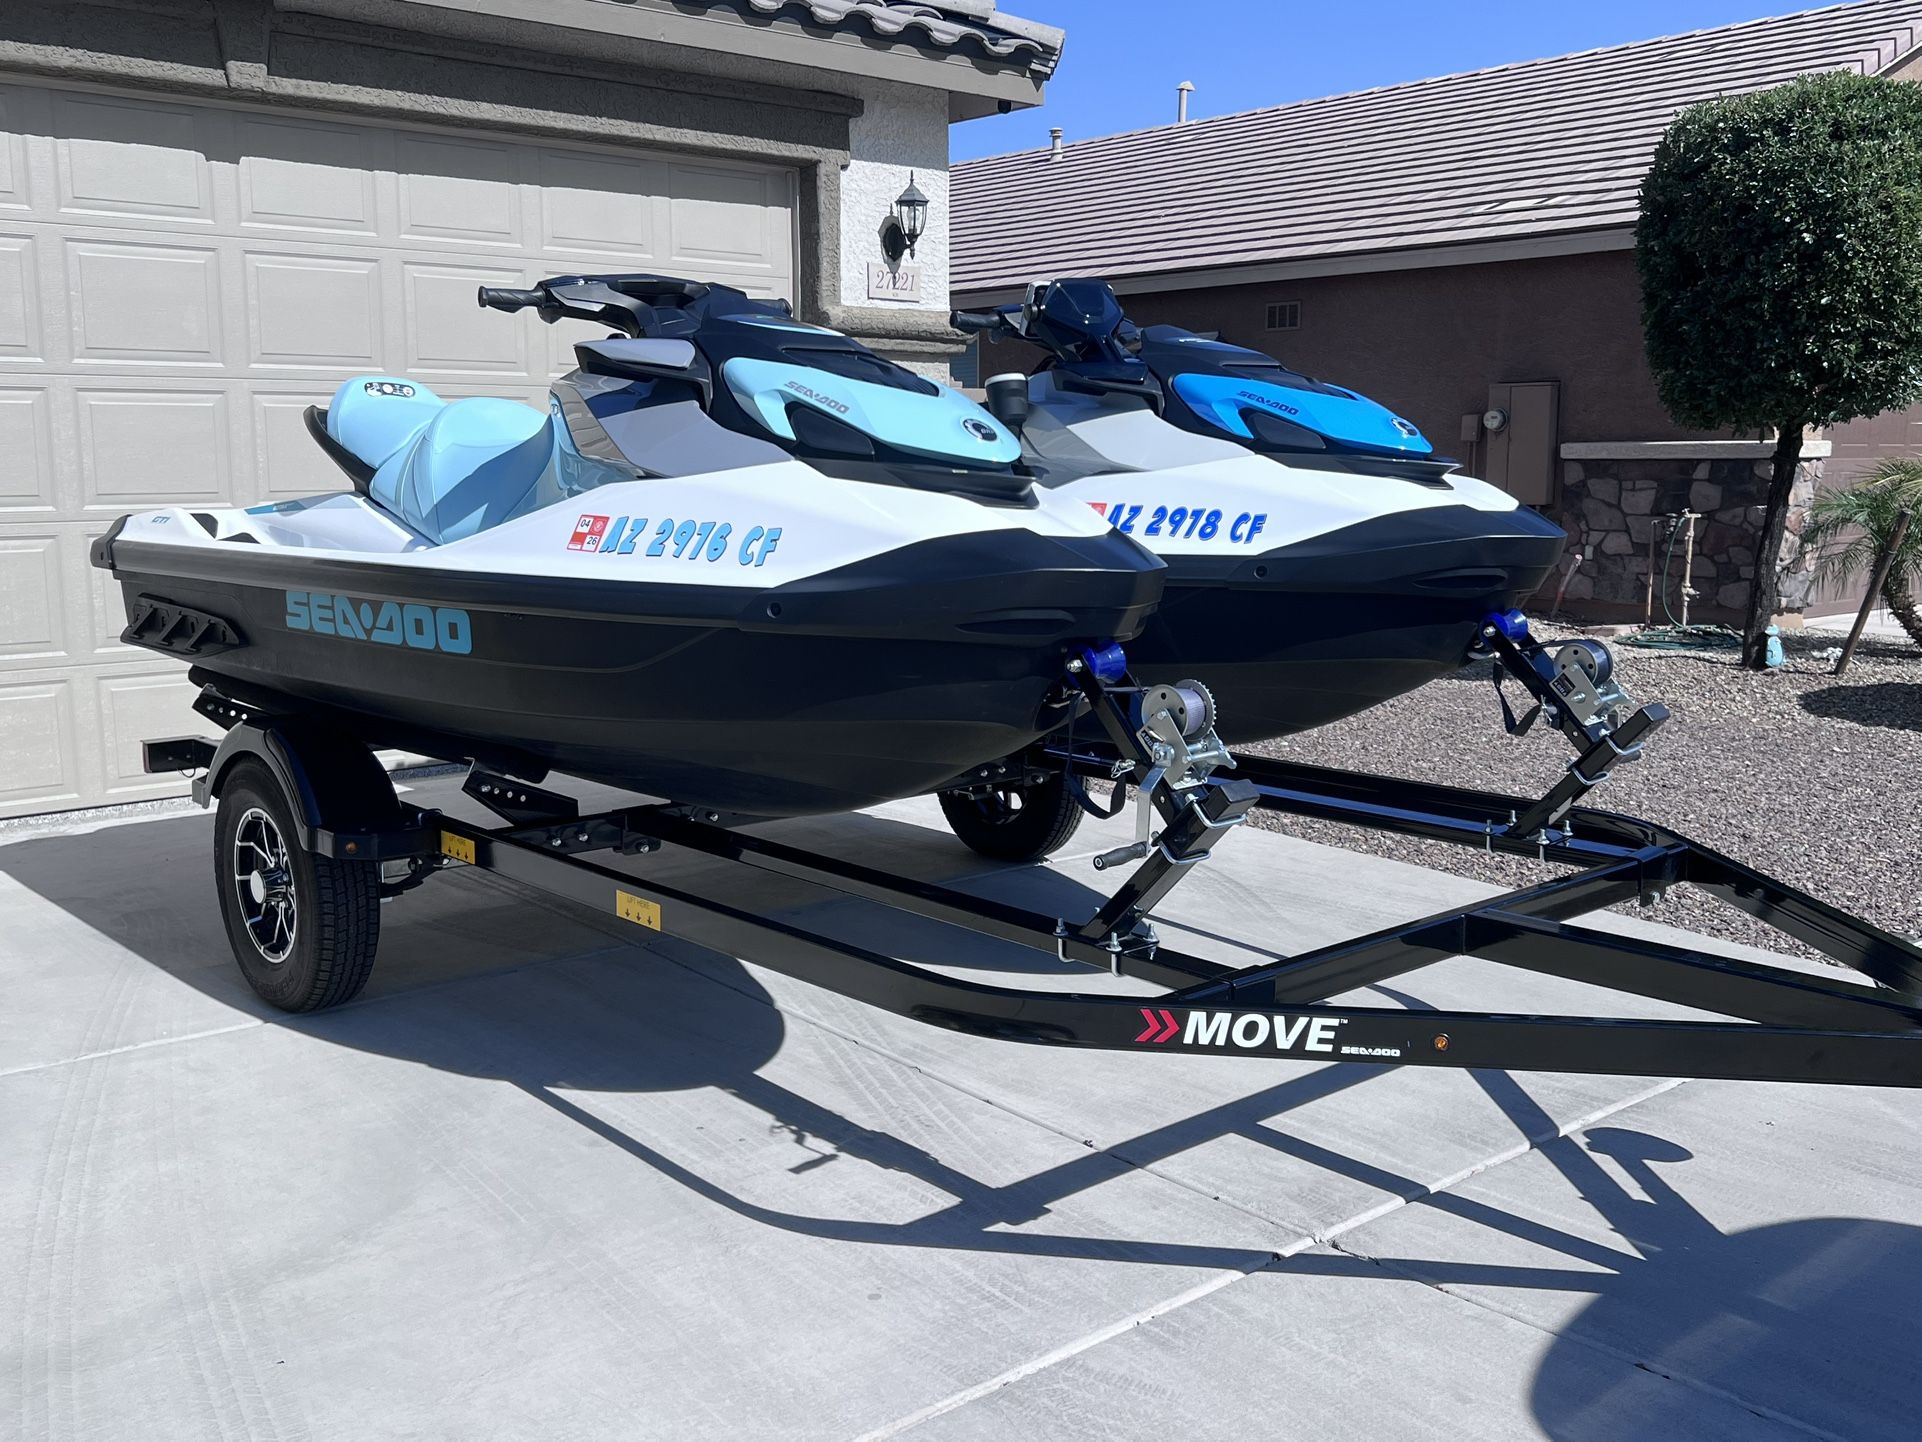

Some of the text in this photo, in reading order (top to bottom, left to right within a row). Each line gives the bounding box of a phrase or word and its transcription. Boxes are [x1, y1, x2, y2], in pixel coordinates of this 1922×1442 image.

[875, 270, 914, 291] 27221
[152, 516, 171, 524] GTI
[580, 519, 590, 528] 04
[1107, 502, 1268, 545] AZ 2978 CF
[586, 535, 597, 545] 26
[598, 515, 782, 567] AZ 2976 CF
[1182, 1010, 1339, 1052] MOVE
